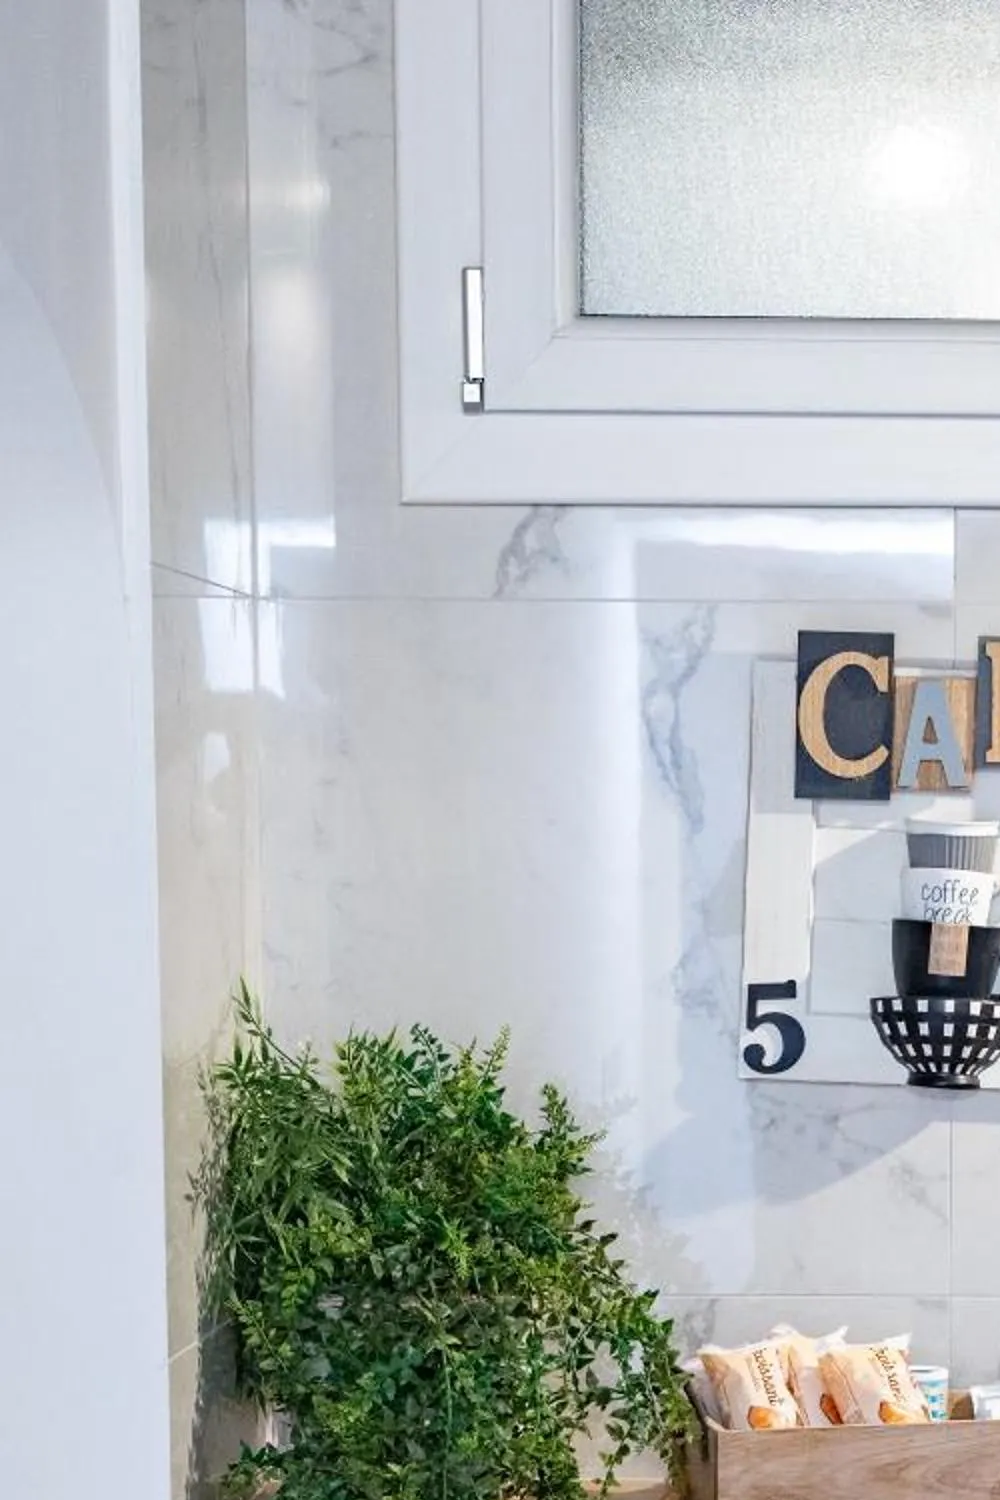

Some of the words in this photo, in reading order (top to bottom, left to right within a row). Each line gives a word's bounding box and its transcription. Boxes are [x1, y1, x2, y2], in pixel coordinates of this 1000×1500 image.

[921, 879, 979, 905] coffee
[743, 979, 806, 1075] 5
[752, 1346, 786, 1407] roissant
